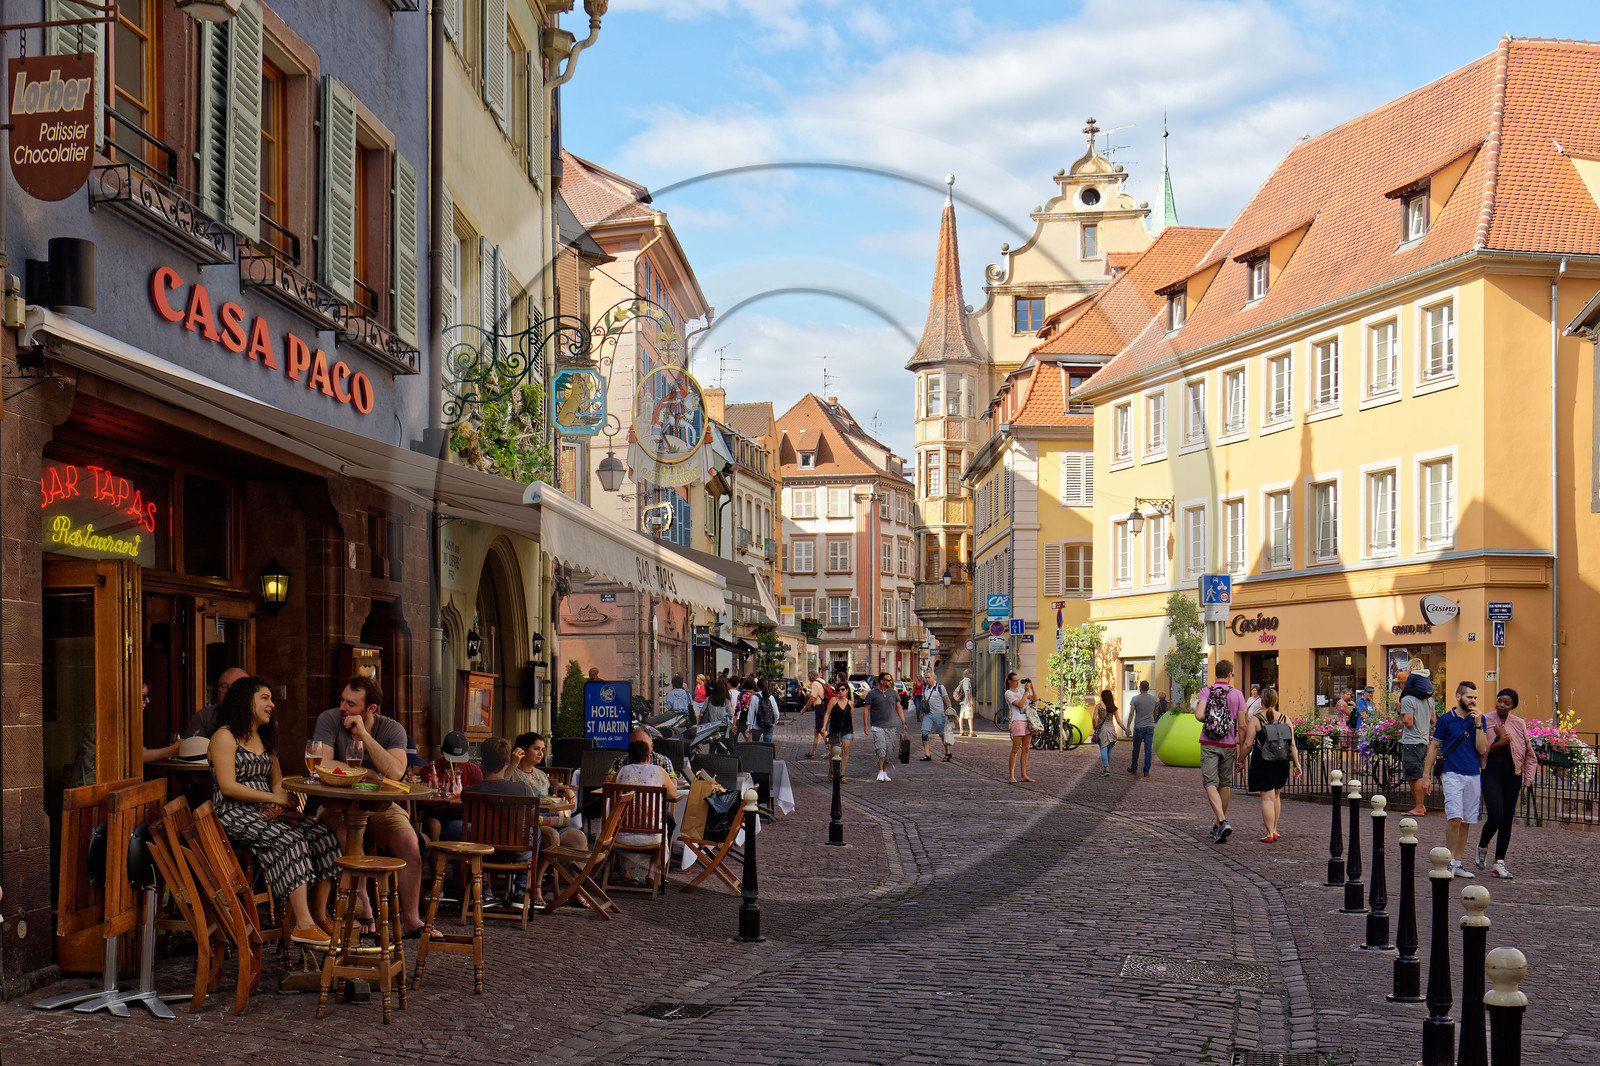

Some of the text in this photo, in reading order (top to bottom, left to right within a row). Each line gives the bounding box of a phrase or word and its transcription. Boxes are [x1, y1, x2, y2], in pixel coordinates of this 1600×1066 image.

[11, 69, 91, 115] Lorber
[39, 120, 89, 142] Patissier
[13, 143, 89, 165] Chocolatier
[151, 266, 374, 415] CASA PACO
[87, 465, 156, 532] TAPAS
[52, 515, 142, 556] Restaurant
[636, 556, 652, 588] BAR
[656, 566, 677, 595] TAPAS
[1426, 604, 1457, 613] Casino
[1231, 612, 1279, 637] Casino
[1392, 624, 1432, 635] GRAND RUE
[1259, 632, 1277, 646] shop
[591, 706, 619, 718] HOTEL
[587, 721, 629, 733] ST MARTIN
